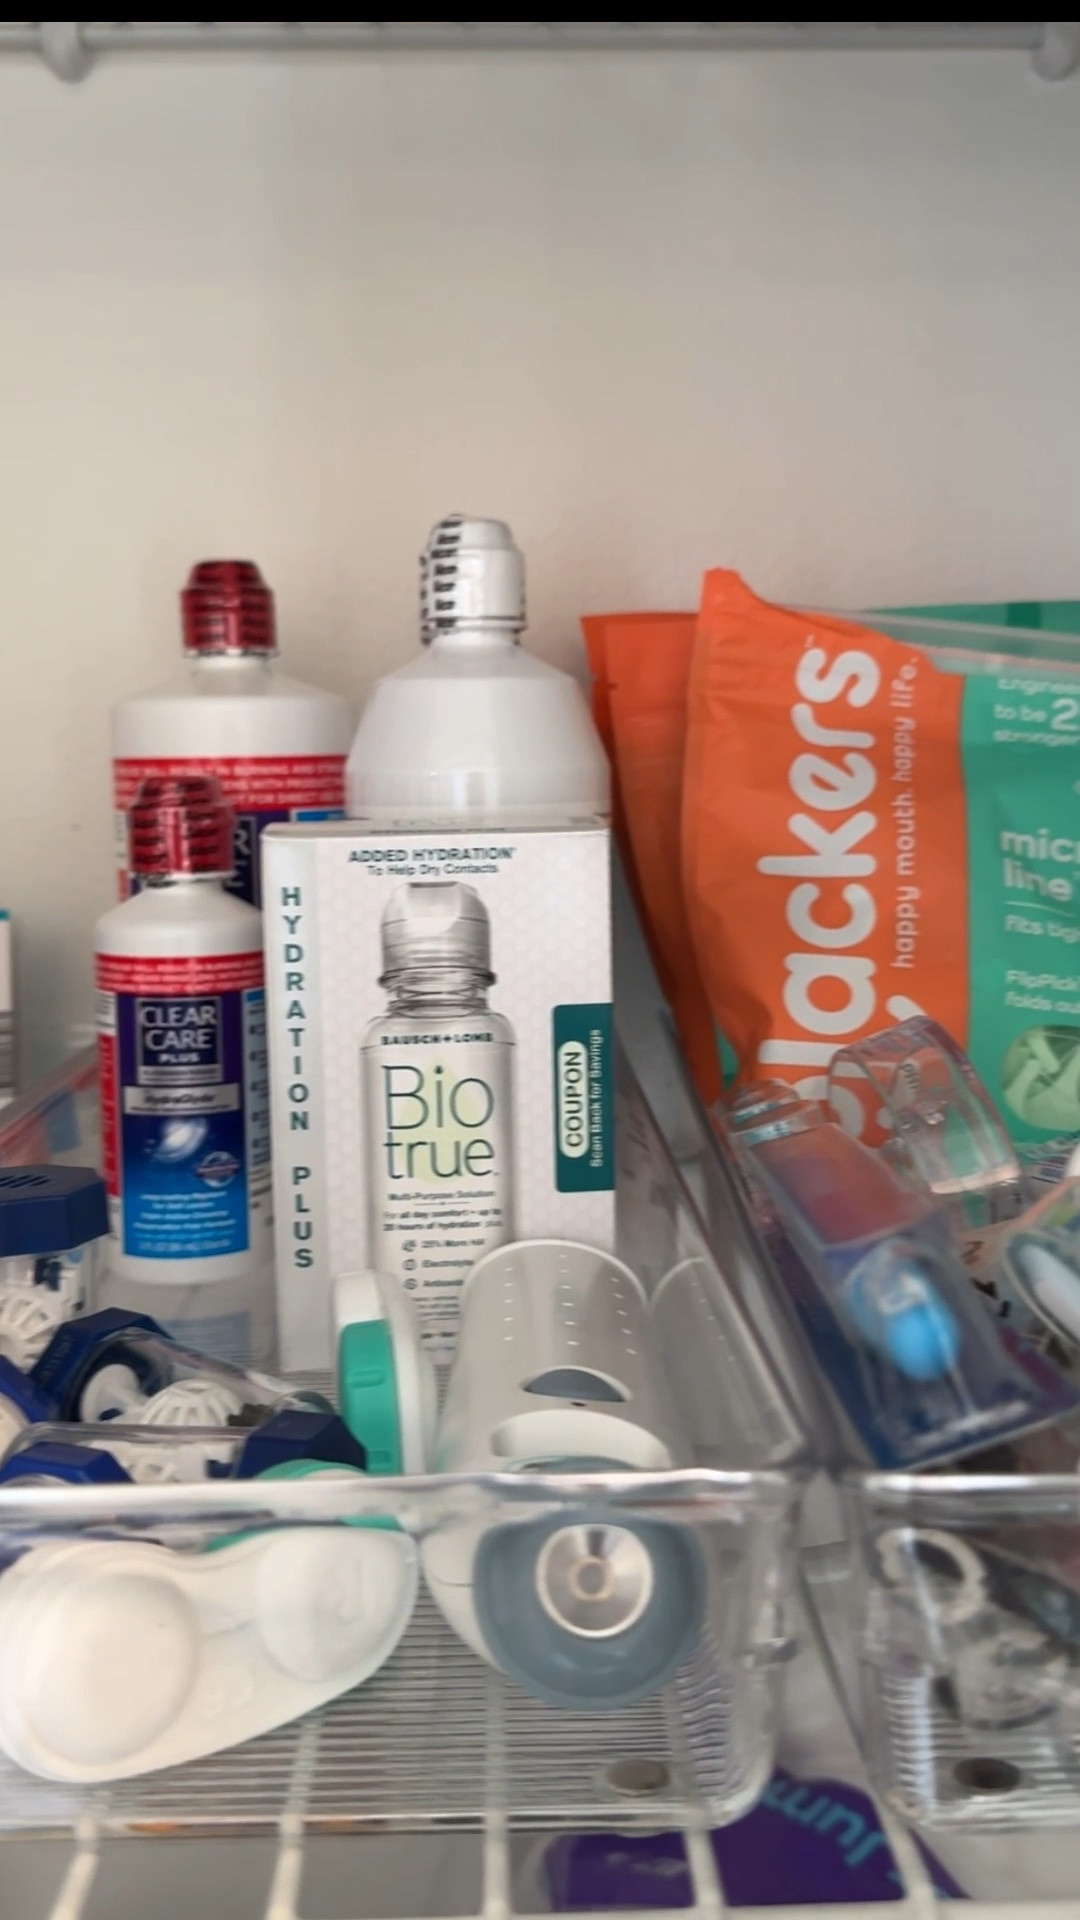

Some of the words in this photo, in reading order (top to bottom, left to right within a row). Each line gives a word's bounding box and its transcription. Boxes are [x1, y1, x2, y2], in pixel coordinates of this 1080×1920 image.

[993, 704, 1017, 719] to
[1020, 704, 1047, 722] be
[890, 715, 917, 784] happy
[348, 849, 408, 862] ADDED
[366, 864, 383, 876] To
[387, 864, 415, 877] Help
[418, 864, 440, 877] Dry
[443, 863, 500, 875] Contacts
[891, 886, 921, 969] happy
[140, 1005, 218, 1028] CLEAR
[280, 886, 310, 1132] HYDRATION
[145, 1028, 214, 1051] CARE
[159, 1051, 200, 1064] PLUS
[381, 1064, 495, 1131] Bio
[563, 1051, 584, 1148] COUPON
[590, 1082, 603, 1099] for
[292, 1165, 314, 1269] PLUS
